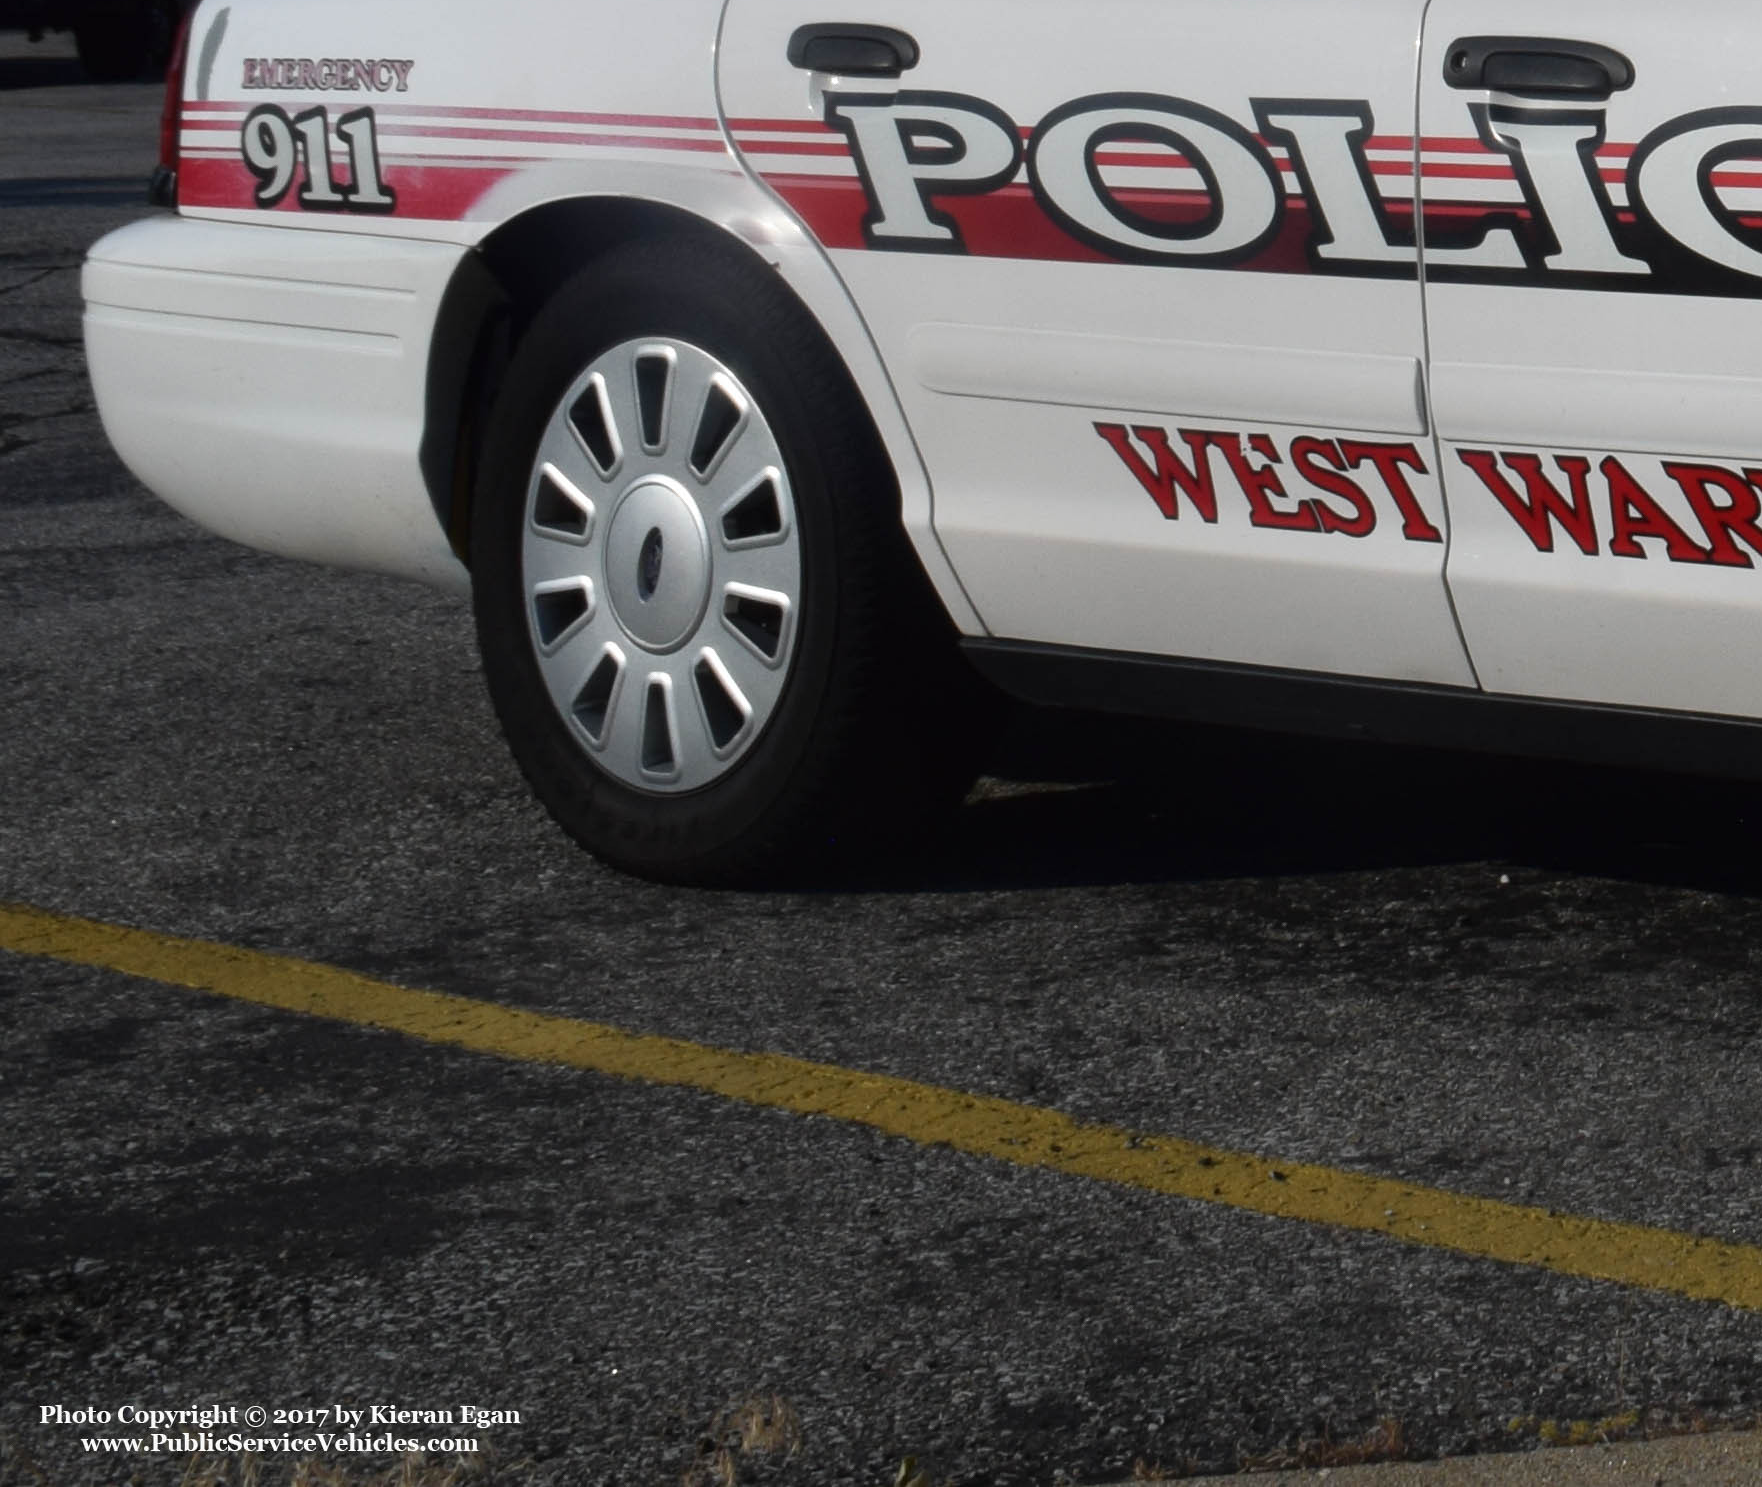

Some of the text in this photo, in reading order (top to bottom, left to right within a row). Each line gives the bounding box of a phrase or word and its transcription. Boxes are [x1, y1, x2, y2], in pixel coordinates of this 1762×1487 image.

[241, 58, 414, 92] EMERGENCY
[241, 103, 395, 213] 911
[1093, 422, 1443, 544] WEST
